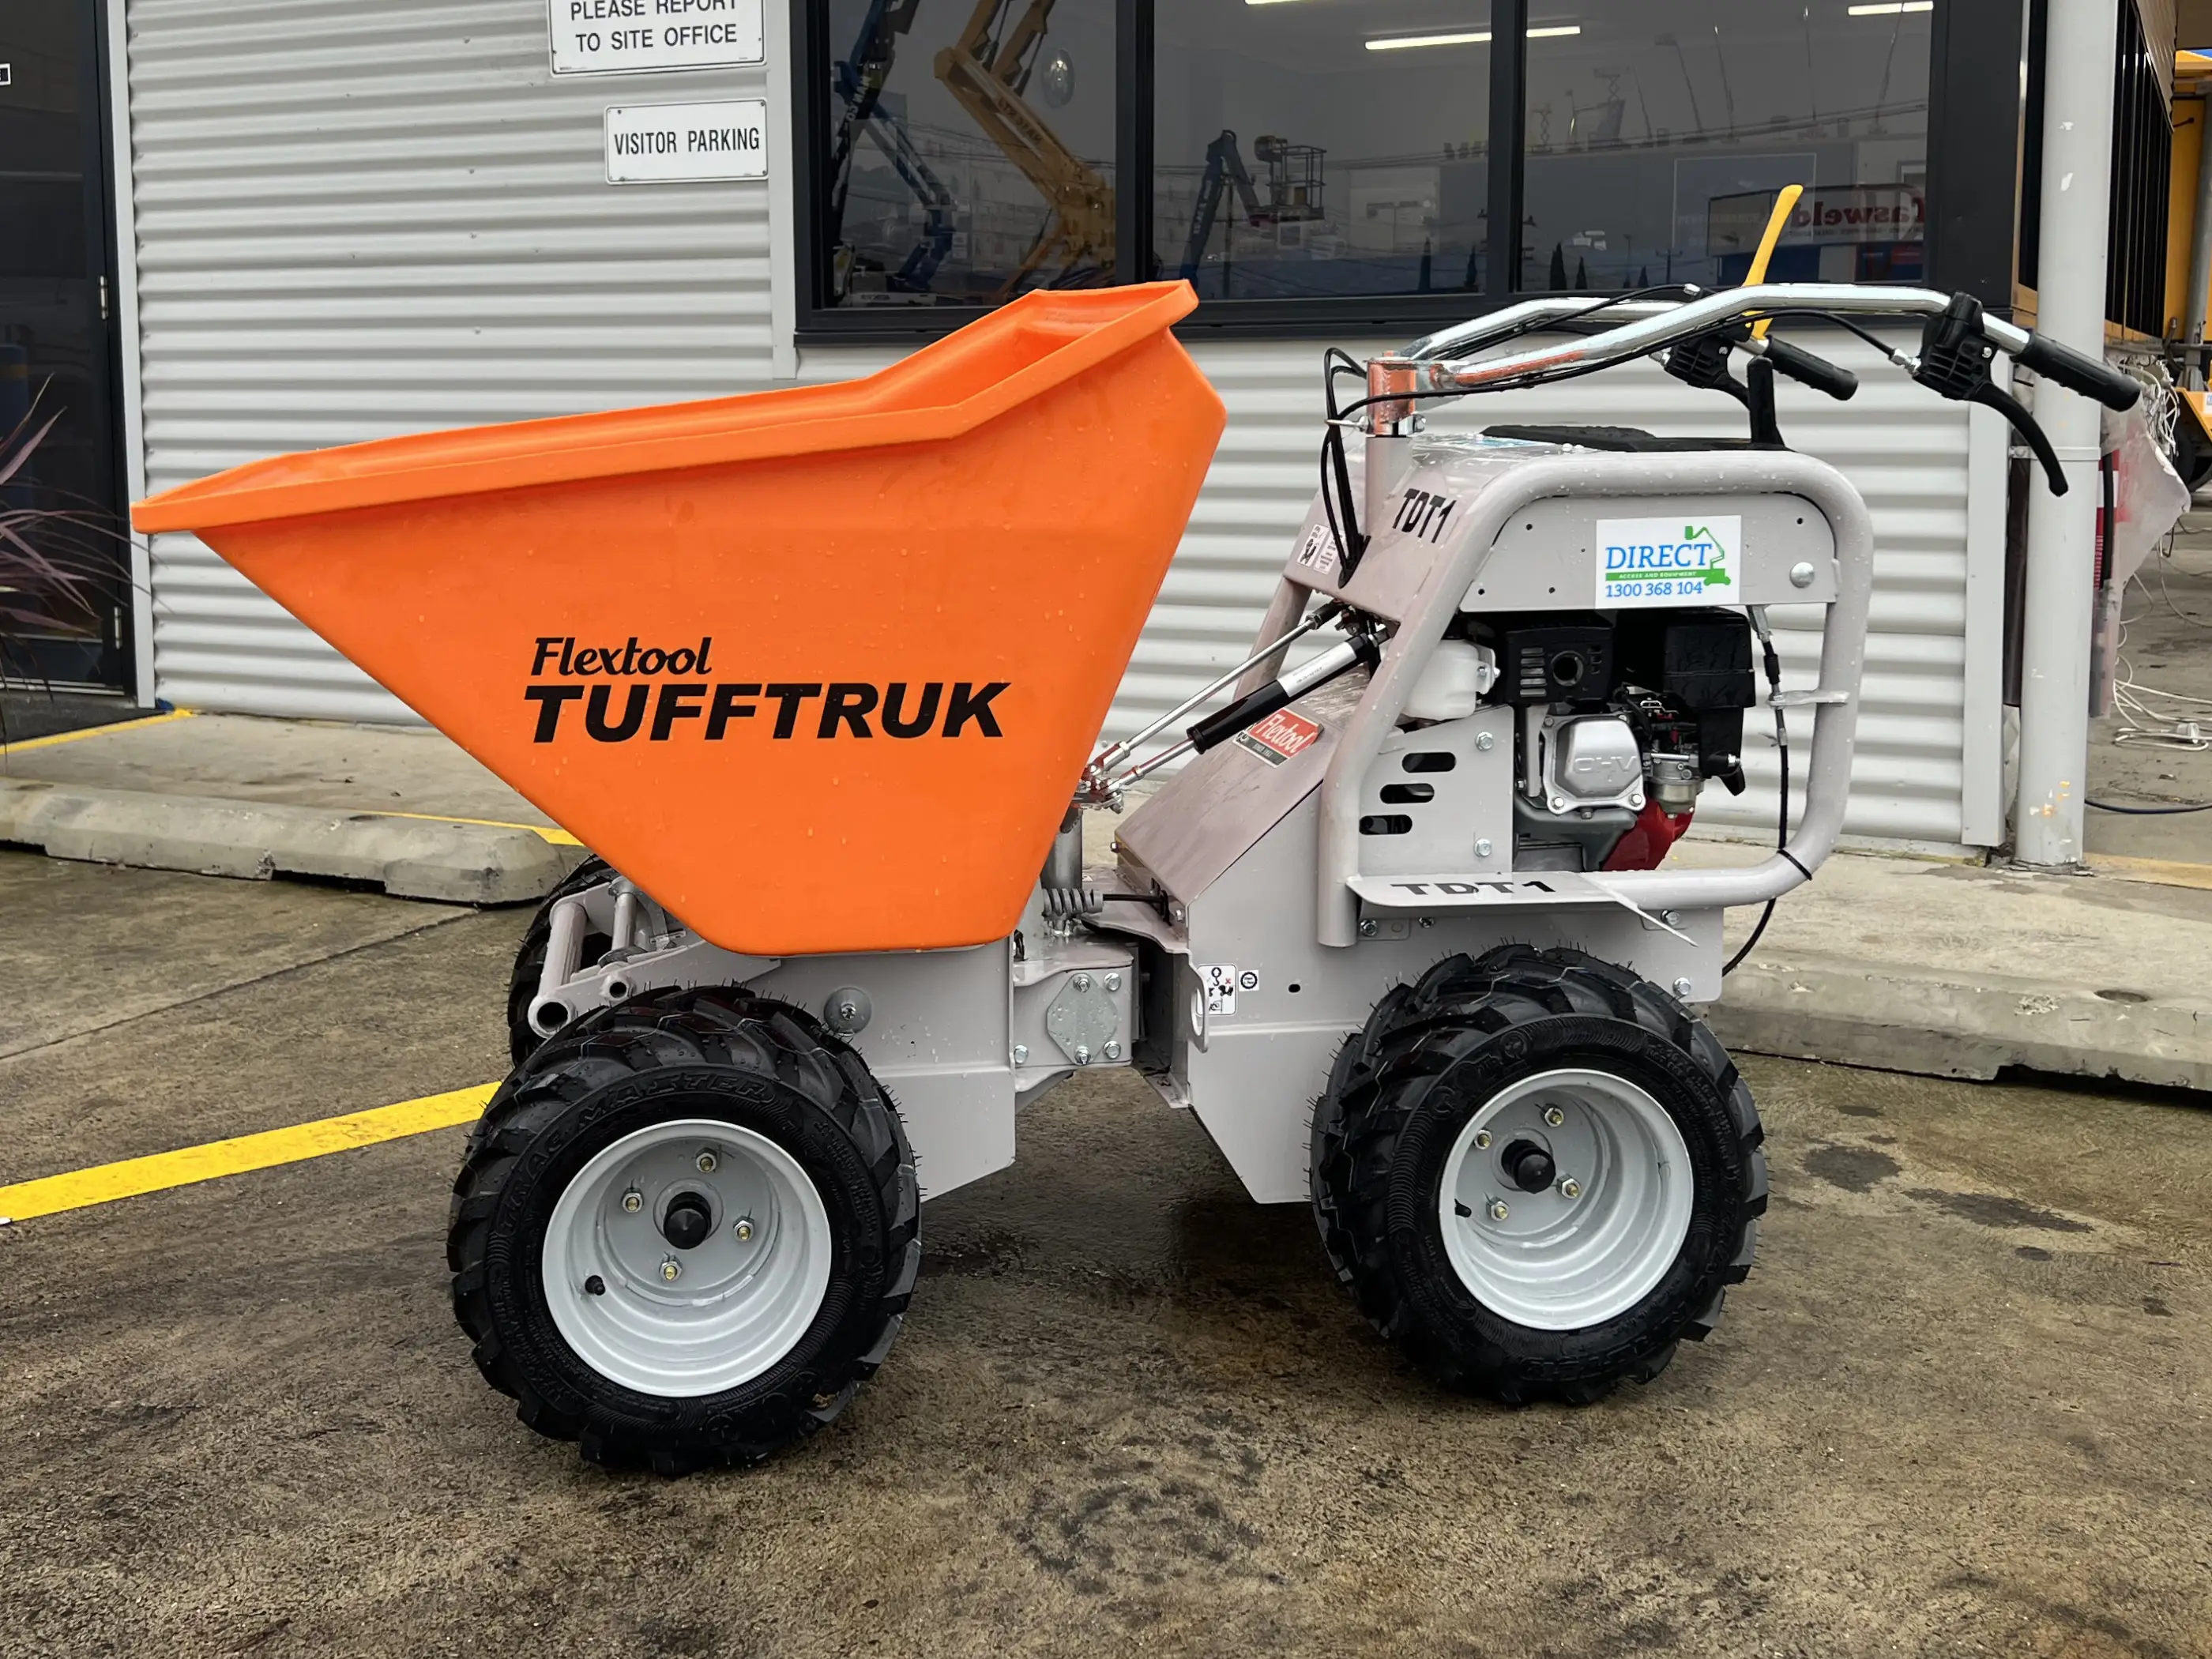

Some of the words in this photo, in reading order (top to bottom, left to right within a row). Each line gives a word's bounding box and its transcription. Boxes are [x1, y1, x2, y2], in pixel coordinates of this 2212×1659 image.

[570, 0, 646, 21] PLEASE
[575, 32, 601, 52] TO
[611, 28, 653, 51] SITE
[664, 23, 737, 47] OFFICE
[614, 131, 677, 156] VISITOR
[687, 126, 760, 152] PARKING
[1391, 487, 1457, 544] TDT1
[1605, 543, 1713, 570] DIRECT
[1605, 583, 1642, 598] 1300
[1644, 581, 1673, 596] 368
[1676, 581, 1703, 595] 104
[529, 635, 713, 676] Flextool
[524, 681, 1012, 743] TUFFTRUK
[1255, 713, 1316, 754] Flextool
[1390, 881, 1556, 895] TDT1
